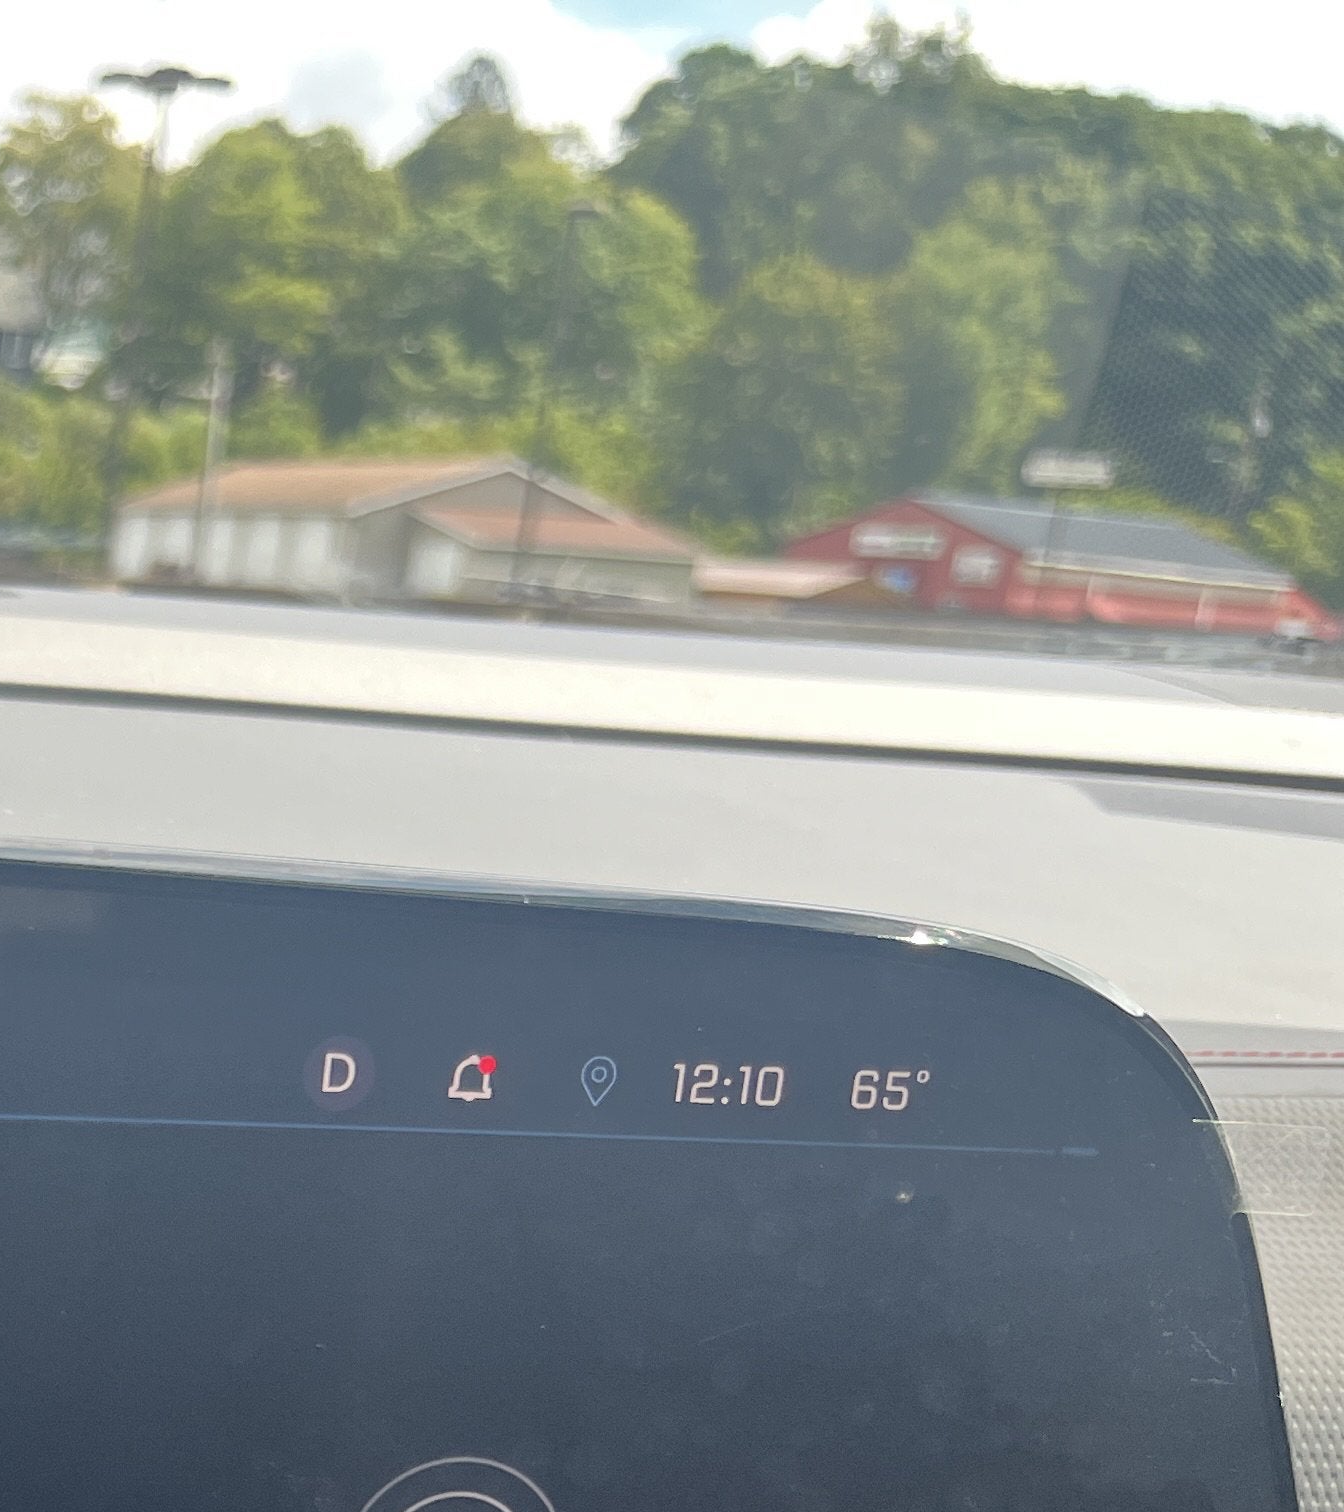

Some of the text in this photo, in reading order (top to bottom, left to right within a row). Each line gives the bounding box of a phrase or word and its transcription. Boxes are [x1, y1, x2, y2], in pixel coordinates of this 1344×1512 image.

[320, 1052, 358, 1094] D
[671, 1062, 785, 1107] 12:10
[849, 1067, 932, 1112] 65°
